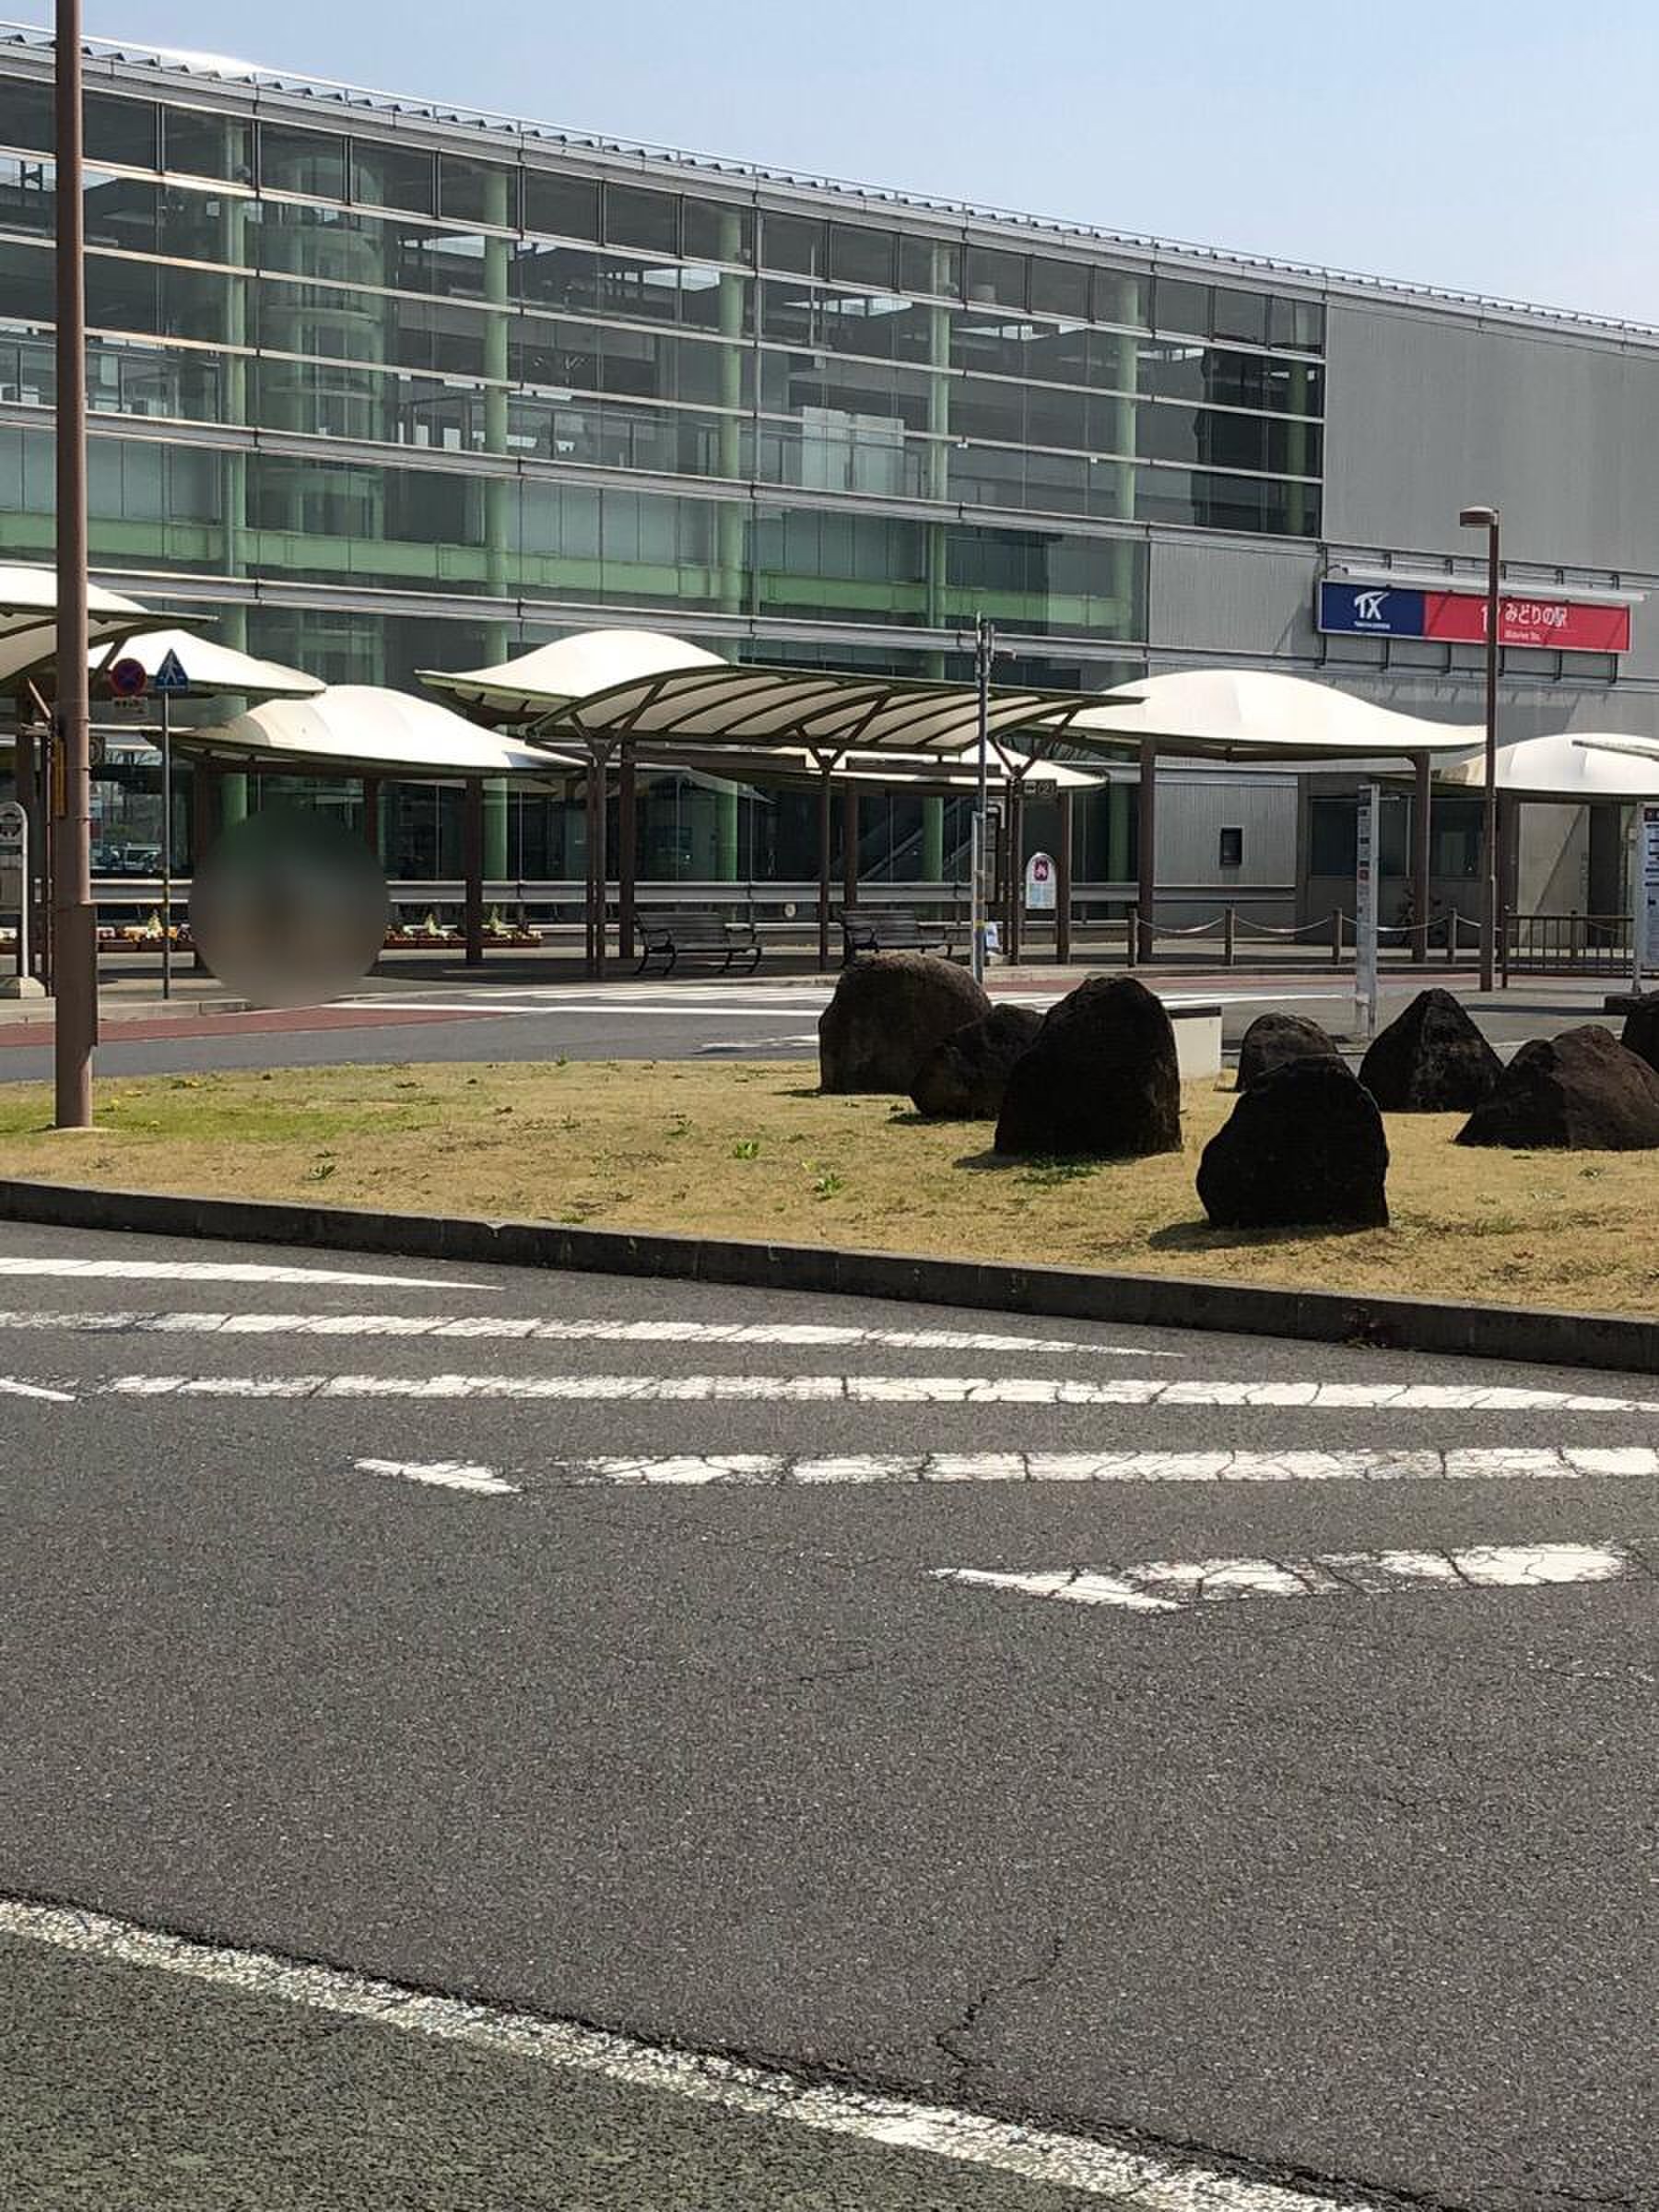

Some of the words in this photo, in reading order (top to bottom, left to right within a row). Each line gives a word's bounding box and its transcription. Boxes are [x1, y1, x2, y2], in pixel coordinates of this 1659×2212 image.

[1354, 591, 1389, 619] TX
[1504, 603, 1568, 628] みどりの駅
